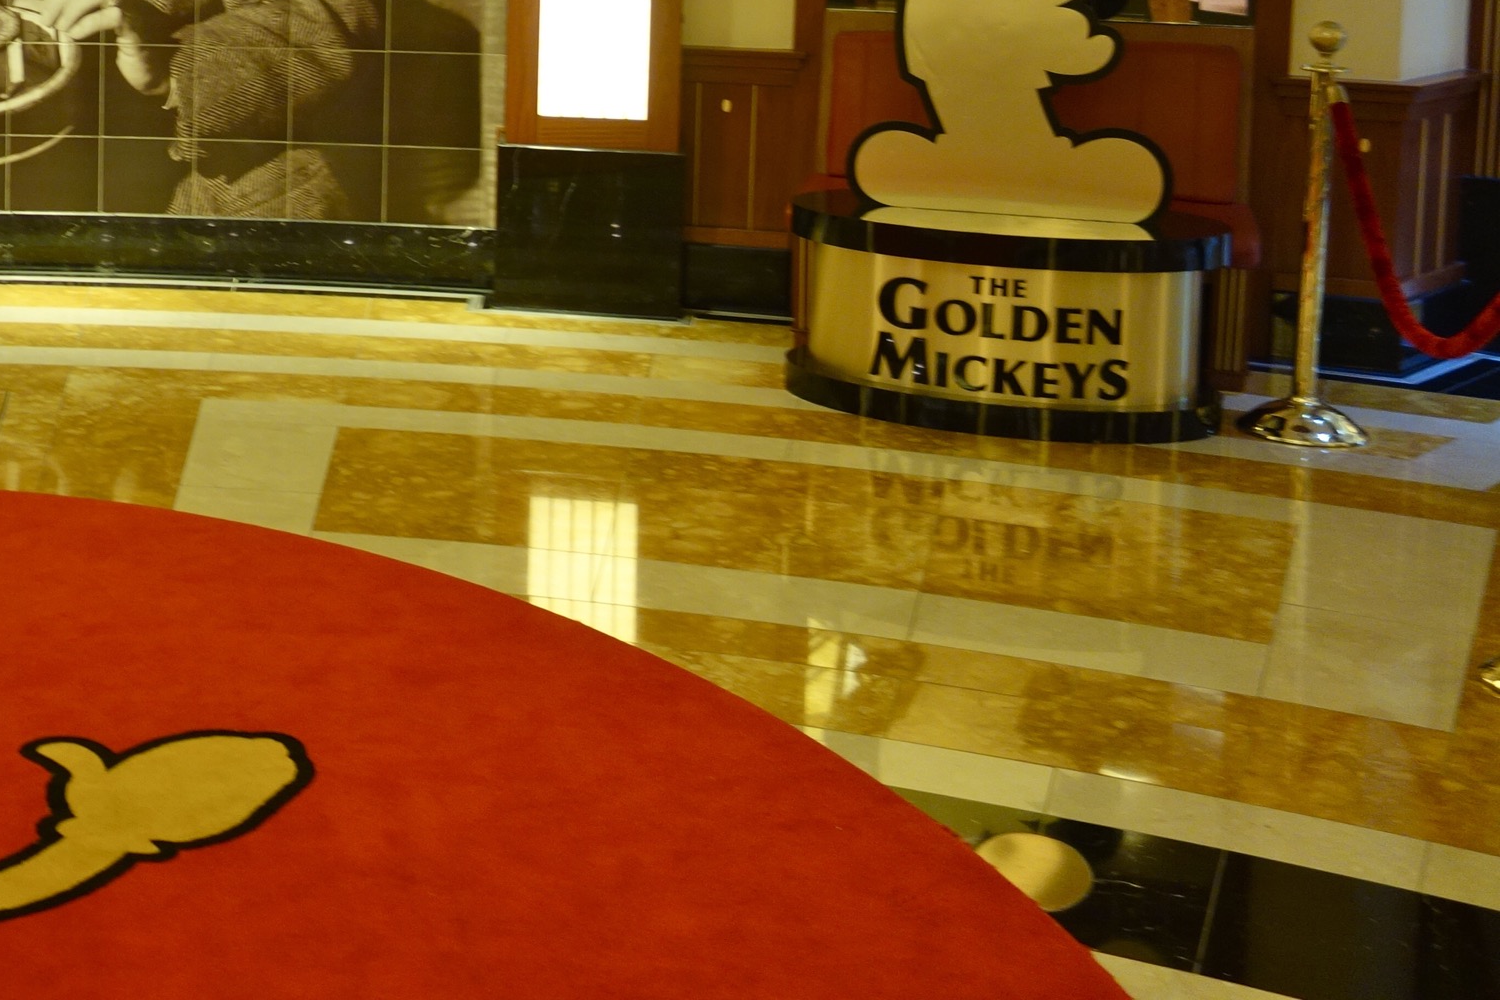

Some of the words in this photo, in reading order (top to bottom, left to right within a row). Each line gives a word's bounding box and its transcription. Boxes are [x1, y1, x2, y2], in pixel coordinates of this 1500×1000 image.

[878, 276, 1123, 346] GOLDEN
[969, 275, 1027, 299] THE
[869, 331, 1130, 401] MICKEYS
